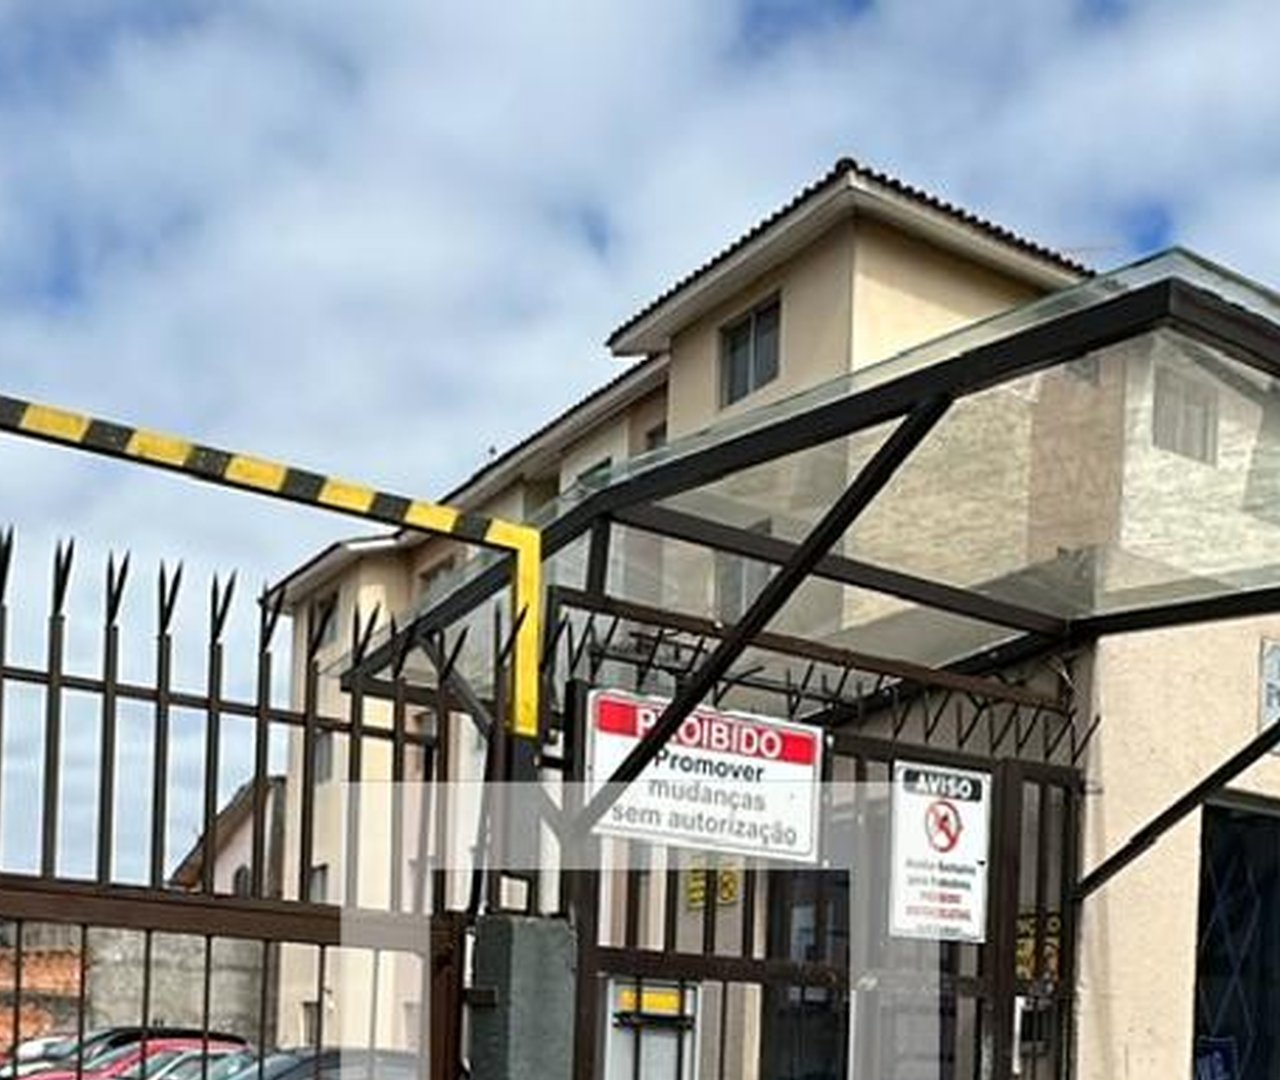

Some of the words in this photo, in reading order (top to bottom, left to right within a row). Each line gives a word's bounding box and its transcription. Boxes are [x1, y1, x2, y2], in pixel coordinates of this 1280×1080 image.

[637, 706, 781, 757] POIBIDO
[654, 748, 765, 782] Promover
[648, 780, 767, 813] mudanças
[917, 772, 973, 799] AVISO
[612, 806, 661, 826] sem
[669, 809, 797, 846] autorização
